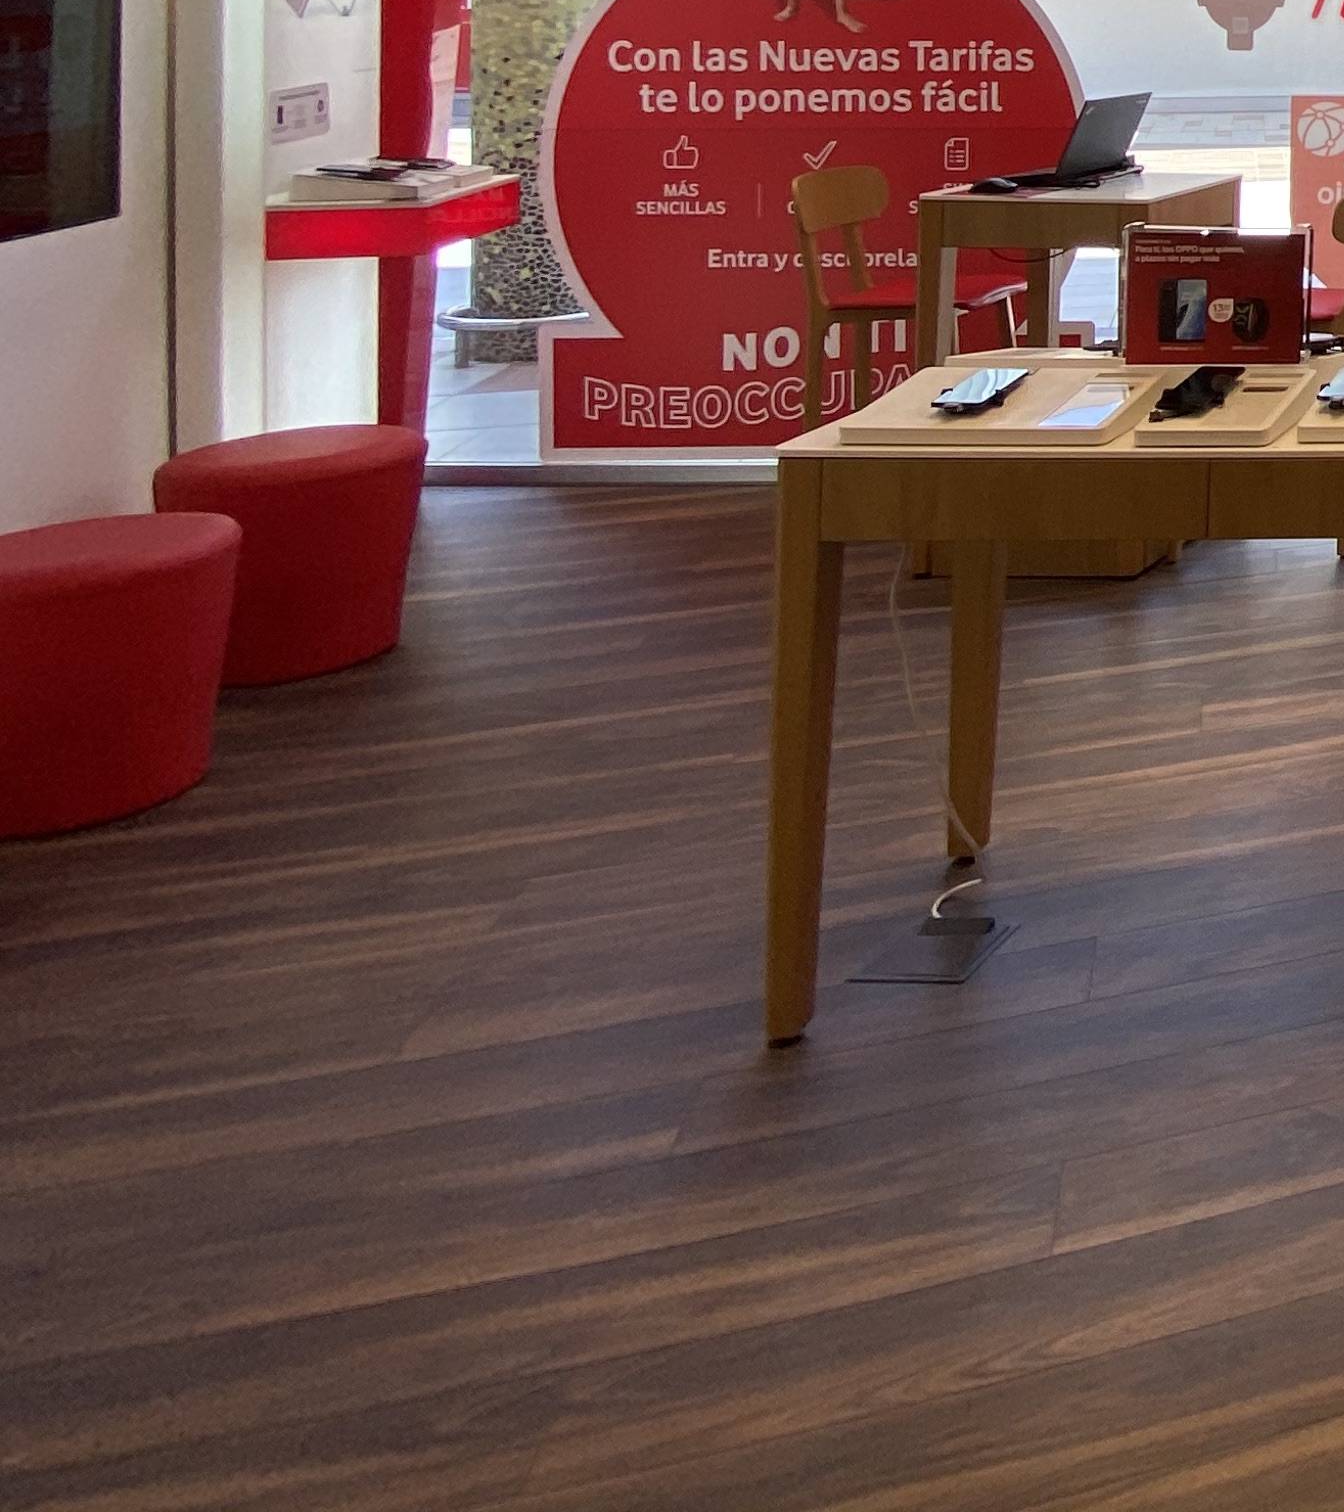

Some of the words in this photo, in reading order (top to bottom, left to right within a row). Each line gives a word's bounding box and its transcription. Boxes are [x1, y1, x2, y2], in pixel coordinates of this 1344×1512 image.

[607, 39, 681, 74] Con
[693, 39, 749, 74] las
[759, 39, 901, 74] Nuevas
[909, 39, 1036, 74] Tarifas
[639, 84, 680, 113] te
[688, 81, 725, 113] lo
[735, 87, 913, 120] ponemos
[921, 79, 1004, 114] fácil
[663, 180, 699, 198] MÁS
[636, 199, 726, 216] SENCILLAS
[708, 248, 769, 269] Entra
[774, 254, 788, 273] y
